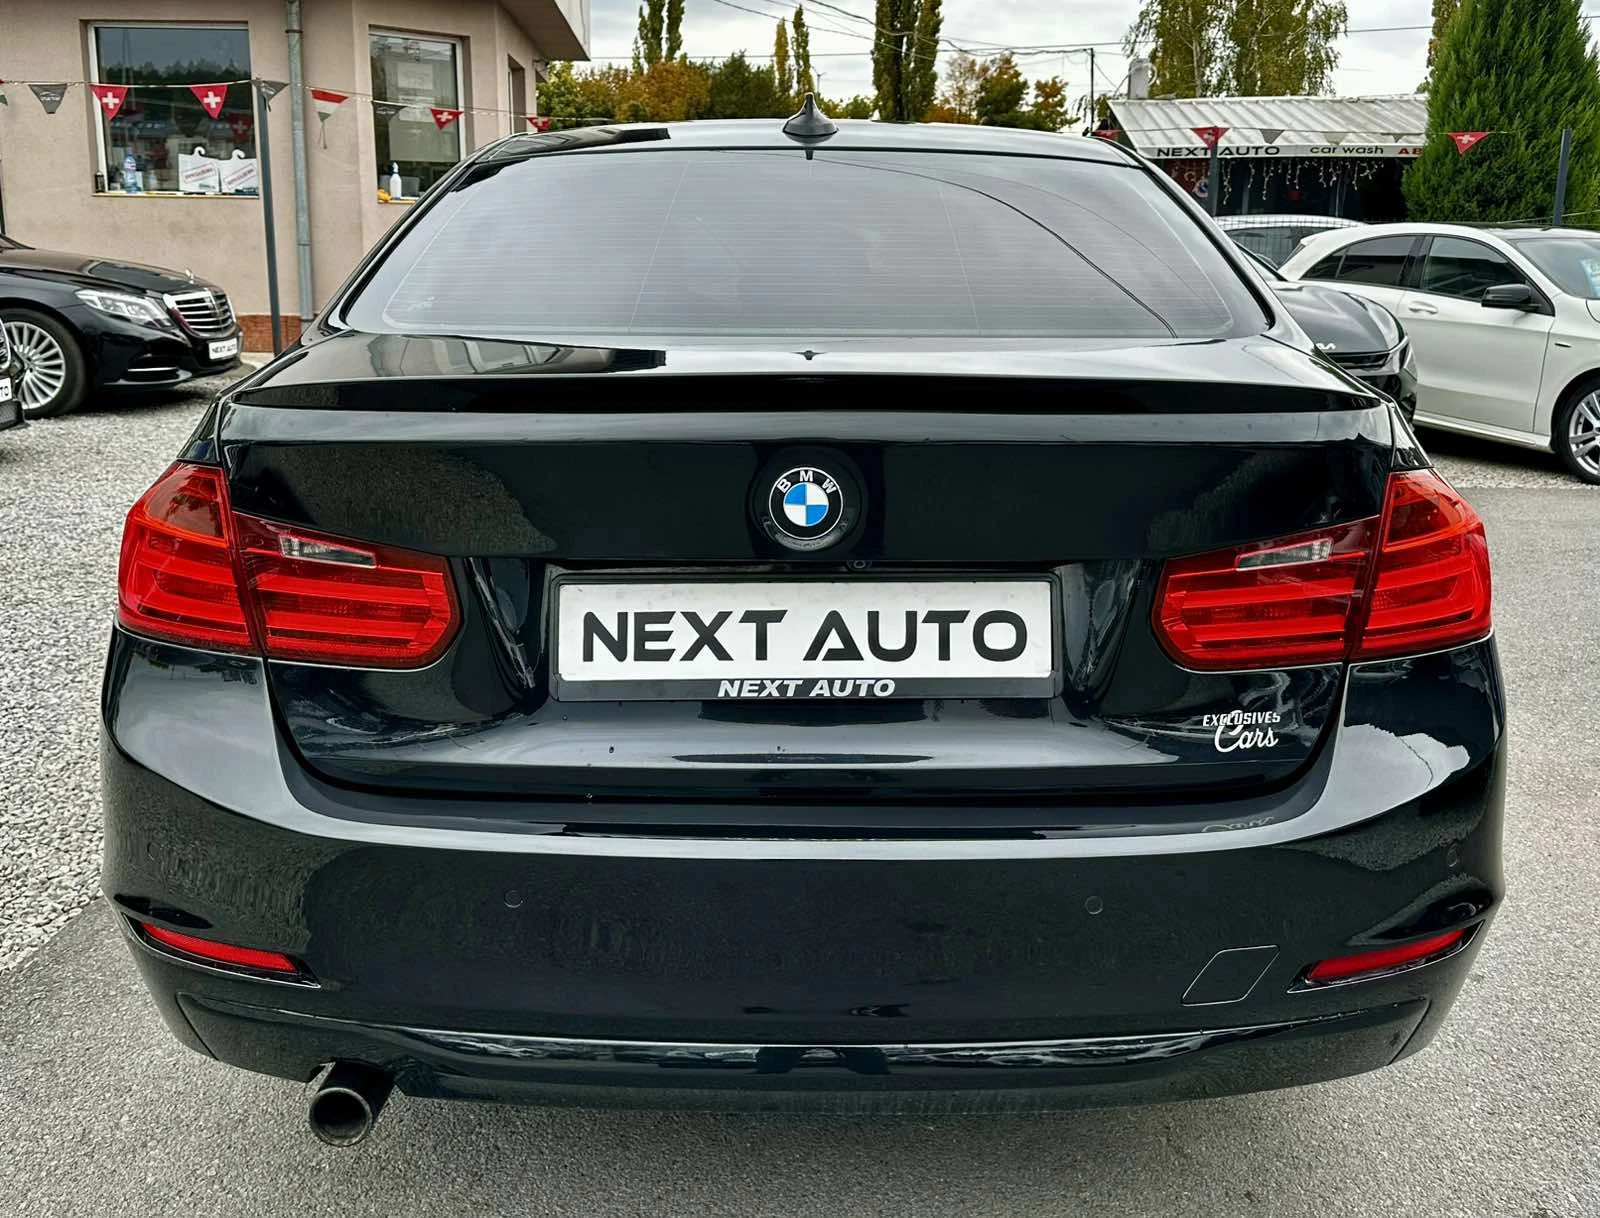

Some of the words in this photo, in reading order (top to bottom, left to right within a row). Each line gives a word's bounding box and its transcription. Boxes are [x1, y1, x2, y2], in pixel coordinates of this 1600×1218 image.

[1157, 147, 1211, 157] NEXT
[1219, 145, 1280, 156] AUTO
[1310, 145, 1338, 154] car
[1342, 145, 1384, 154] wash
[776, 470, 838, 494] BMW
[583, 610, 788, 663] NEXT
[803, 610, 1028, 663] AUTO
[717, 679, 804, 698] NEXT
[809, 678, 896, 698] AUTO
[1202, 711, 1281, 727] EXCLUSIVES
[1214, 709, 1279, 753] Cars
